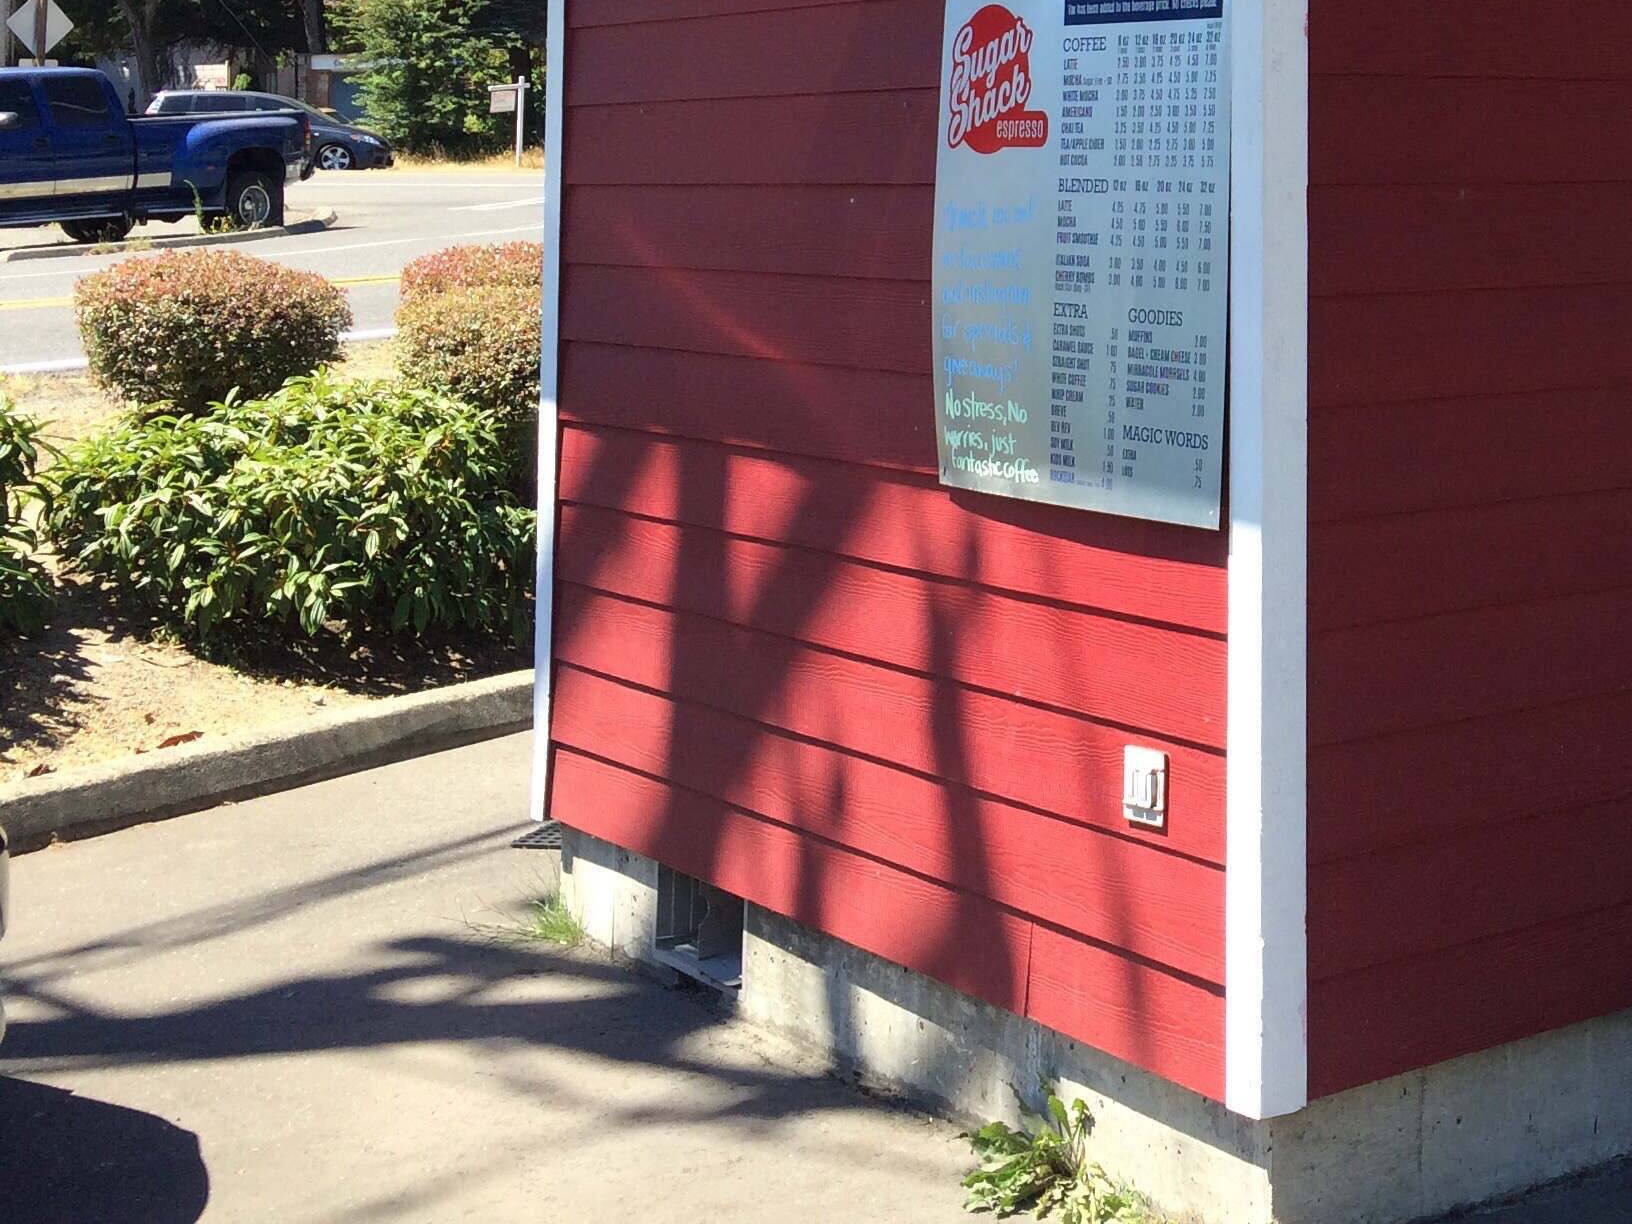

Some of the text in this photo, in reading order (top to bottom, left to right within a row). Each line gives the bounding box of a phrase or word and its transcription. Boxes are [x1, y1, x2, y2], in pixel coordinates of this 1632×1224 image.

[1063, 36, 1106, 52] COFFEE
[953, 19, 1032, 91] Sugar
[949, 64, 1030, 146] Shack
[1062, 106, 1092, 118] AMERICANO
[996, 118, 1044, 140] espresso
[1058, 178, 1108, 194] BLENDED
[1054, 302, 1088, 319] EXTRA
[1128, 308, 1183, 326] GOODIES
[1053, 323, 1068, 336] EXTRA
[1128, 330, 1152, 344] MUFFINS
[1052, 340, 1076, 353] CARAMEL
[1128, 346, 1190, 364] BAGEL CREAM CHEESE
[1126, 380, 1144, 394] SUGAR
[1146, 382, 1170, 396] COOKIES
[946, 388, 1028, 426] No stress, No
[1126, 397, 1144, 410] WATER
[990, 428, 1017, 458] just
[1122, 425, 1208, 450] MAGIC WORDS
[1003, 458, 1040, 484] coffee
